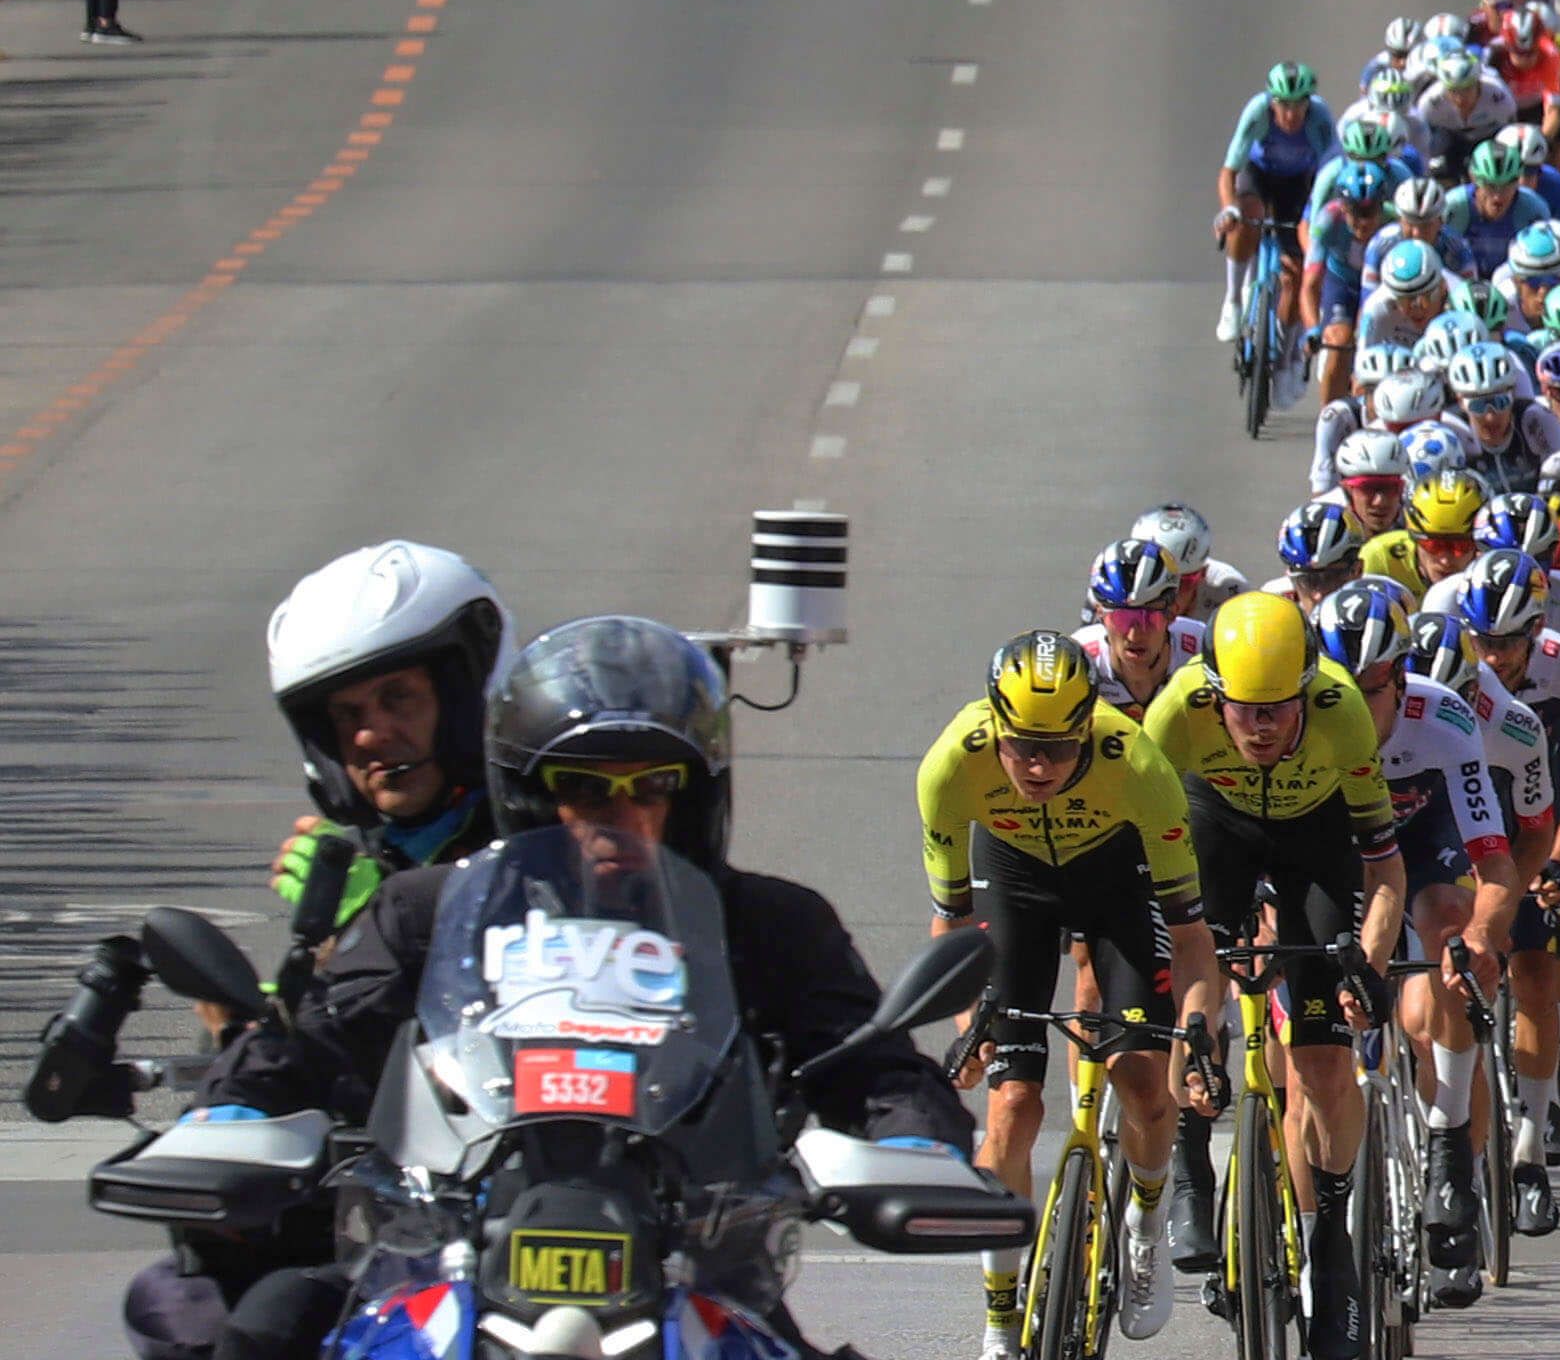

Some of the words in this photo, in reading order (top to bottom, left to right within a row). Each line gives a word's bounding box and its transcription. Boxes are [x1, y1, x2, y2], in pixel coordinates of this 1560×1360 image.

[1035, 634, 1057, 682] GIRO
[1461, 760, 1491, 824] BOSS
[1523, 755, 1543, 807] BOSS
[1027, 817, 1101, 829] VISMA
[482, 908, 679, 1003] rtve
[541, 1073, 608, 1105] 5332
[520, 1246, 608, 1294] META
